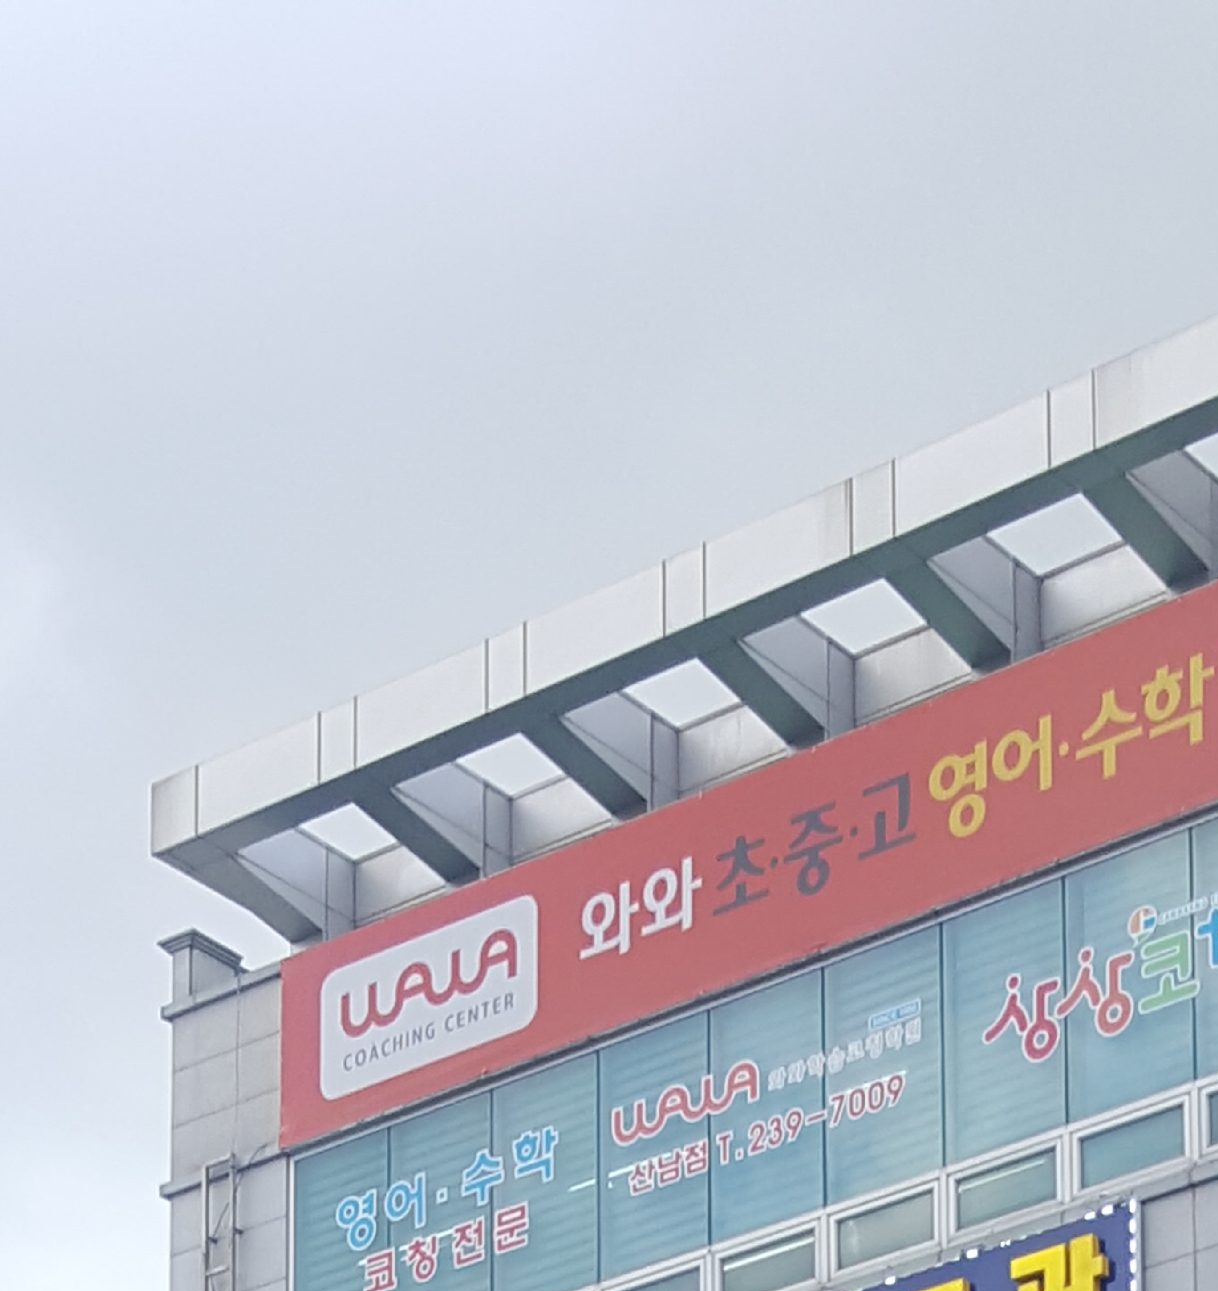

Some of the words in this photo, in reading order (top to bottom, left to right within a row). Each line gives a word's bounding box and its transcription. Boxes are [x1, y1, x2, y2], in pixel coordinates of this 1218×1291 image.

[579, 856, 702, 960] 와와
[928, 654, 1214, 838] 영어·수학
[343, 1022, 437, 1071] COACHING
[445, 992, 515, 1038] CENTER
[628, 1139, 709, 1197] 산남점
